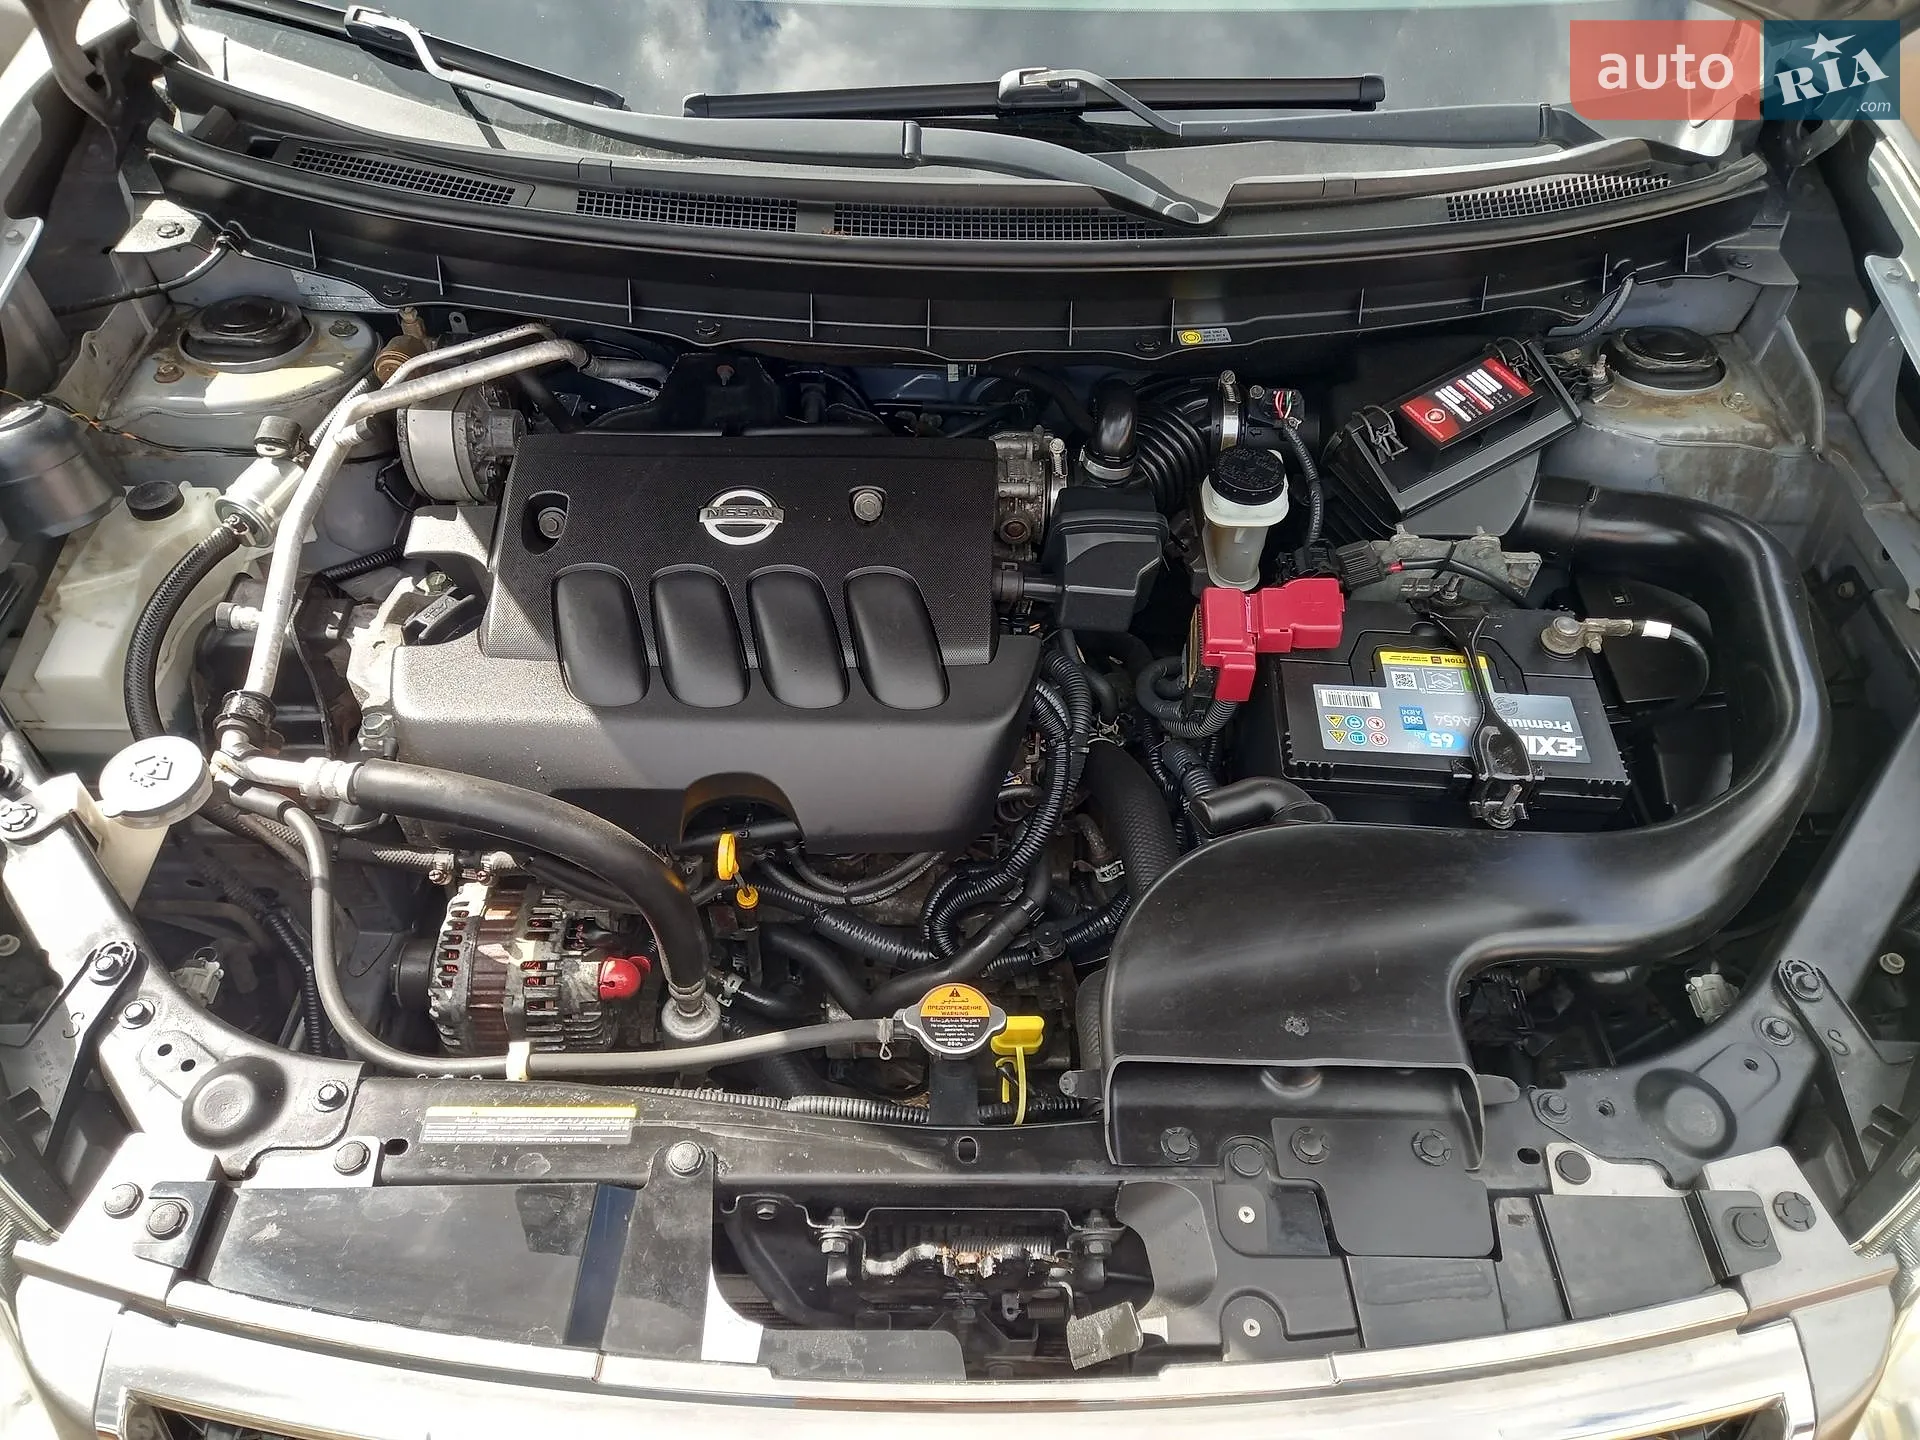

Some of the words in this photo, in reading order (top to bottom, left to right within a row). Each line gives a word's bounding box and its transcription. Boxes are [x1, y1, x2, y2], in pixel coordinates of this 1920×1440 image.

[706, 506, 775, 518] NISSAN
[1403, 715, 1424, 725] 580
[1428, 732, 1456, 749] 65
